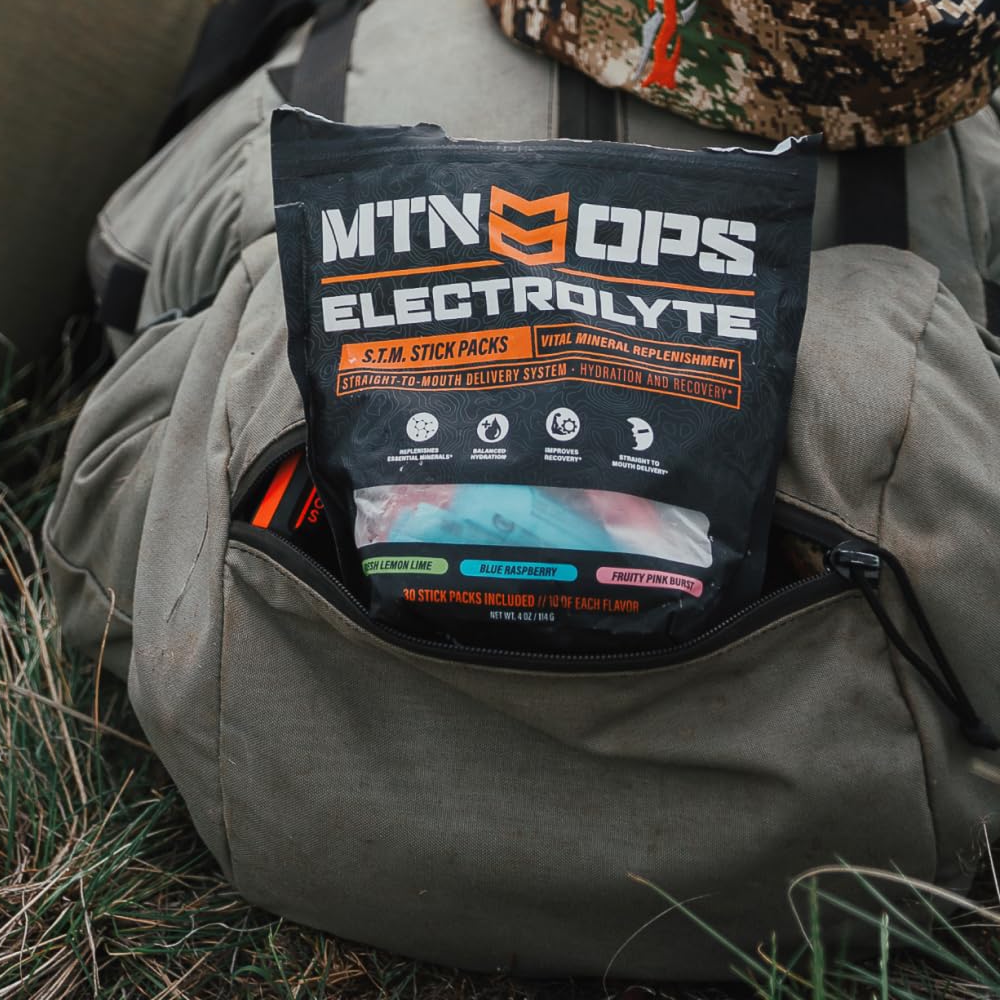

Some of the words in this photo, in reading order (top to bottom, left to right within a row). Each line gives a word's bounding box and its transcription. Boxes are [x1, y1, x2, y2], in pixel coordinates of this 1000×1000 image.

[321, 193, 481, 263] MTN
[575, 203, 757, 277] OPS
[321, 276, 758, 341] ELECTROLYTE
[361, 346, 406, 364] S.T.M.
[410, 341, 456, 362] STICK
[457, 335, 509, 357] PACKS
[541, 333, 572, 348] VITAL
[575, 332, 630, 353] MINERAL
[632, 345, 735, 370] REPLENISHMENT
[342, 373, 462, 391] STRAIGHT-TO-MOUTH
[466, 368, 520, 386] DELIVERY
[523, 363, 567, 381] SYSTEM
[579, 363, 642, 385] HYDRATION
[647, 374, 669, 389] AND
[399, 447, 440, 455] REPLENISHES
[544, 447, 579, 455] IMPROVES
[387, 455, 418, 463] ESSENTIAL
[611, 460, 636, 470] MOUTH
[619, 454, 650, 465] STRAIGHT
[380, 560, 409, 571] LEMON
[410, 560, 433, 571] LIME
[479, 563, 503, 575] BLUE
[504, 564, 558, 577] RASPBERRY
[611, 571, 645, 584] FRUITY
[645, 573, 668, 585] PINK
[669, 576, 695, 590] BURST
[403, 588, 416, 601] 30
[418, 588, 447, 603] STICK
[449, 589, 481, 605] PACKS
[484, 592, 535, 608] INCLUDED
[549, 594, 559, 608] 10
[560, 594, 573, 609] OF
[575, 596, 600, 611] EACH
[602, 599, 640, 613] FLAVOR
[490, 611, 503, 620] NET
[504, 611, 516, 621] WT.
[517, 611, 522, 620] 4
[523, 612, 532, 621] OZ
